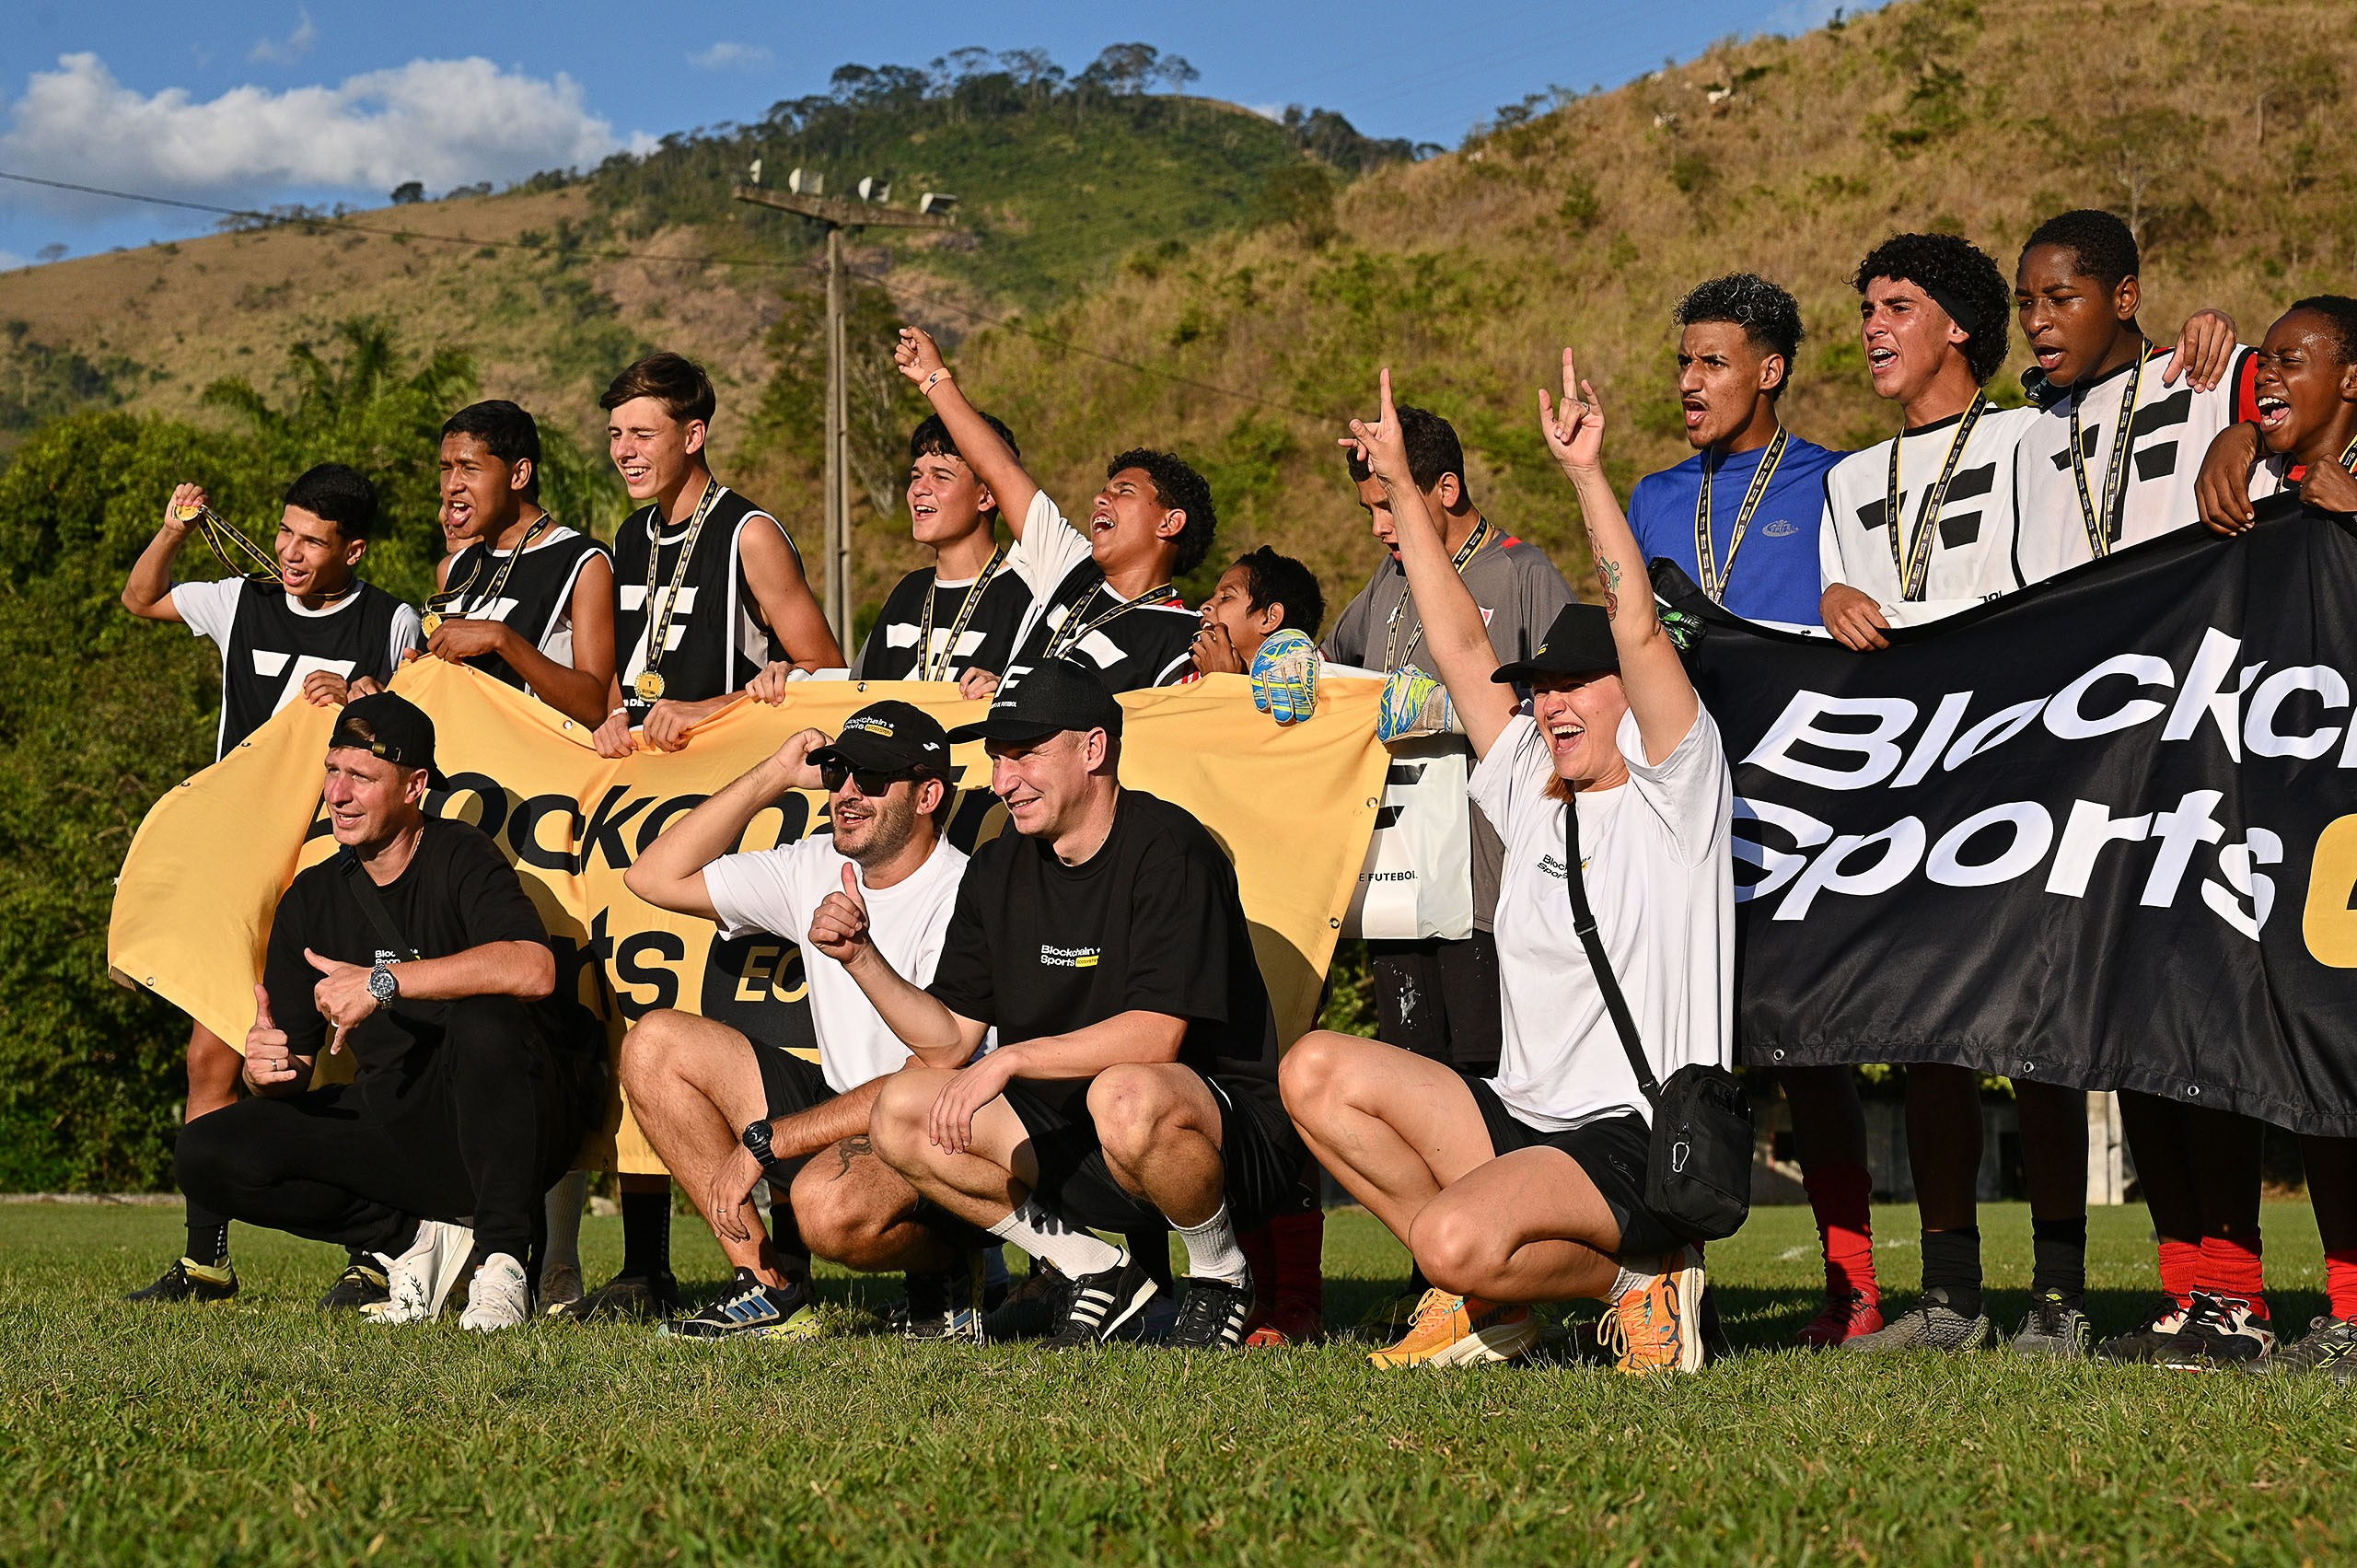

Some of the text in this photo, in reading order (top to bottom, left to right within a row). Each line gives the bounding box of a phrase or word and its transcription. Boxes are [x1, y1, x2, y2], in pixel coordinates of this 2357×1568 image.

[1738, 626, 2357, 791] Blockc
[1734, 789, 2283, 942] Sports
[1040, 945, 1095, 957] Blockchain
[1040, 954, 1074, 966] Sports
